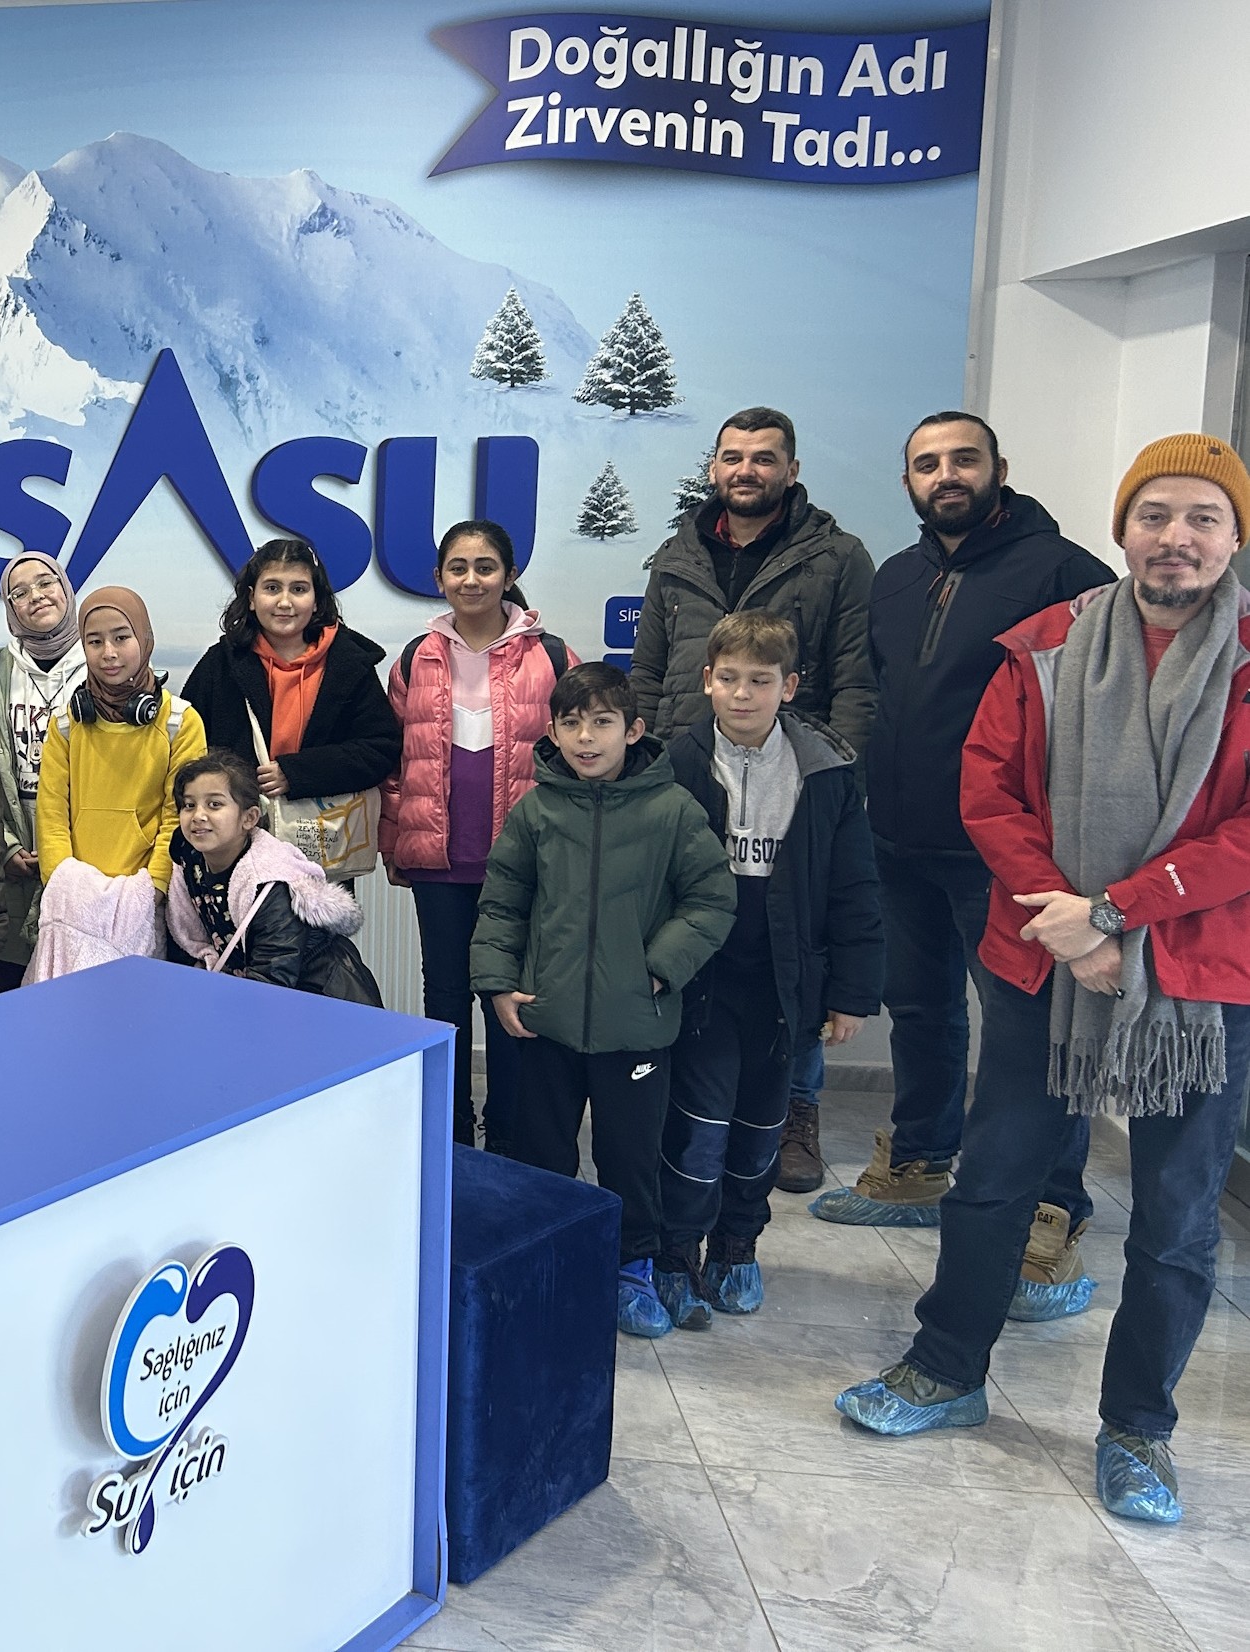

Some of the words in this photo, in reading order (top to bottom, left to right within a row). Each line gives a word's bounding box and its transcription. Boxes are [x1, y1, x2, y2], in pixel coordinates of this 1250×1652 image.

[507, 26, 826, 104] Doğallığın
[837, 38, 949, 98] Adı
[504, 91, 746, 159] Zirvenin
[761, 110, 943, 169] Tadı...
[1037, 1211, 1054, 1225] CAT
[140, 1324, 227, 1381] Sağlığınız
[158, 1380, 191, 1422] için
[89, 1480, 138, 1533] Su
[169, 1435, 226, 1500] için
